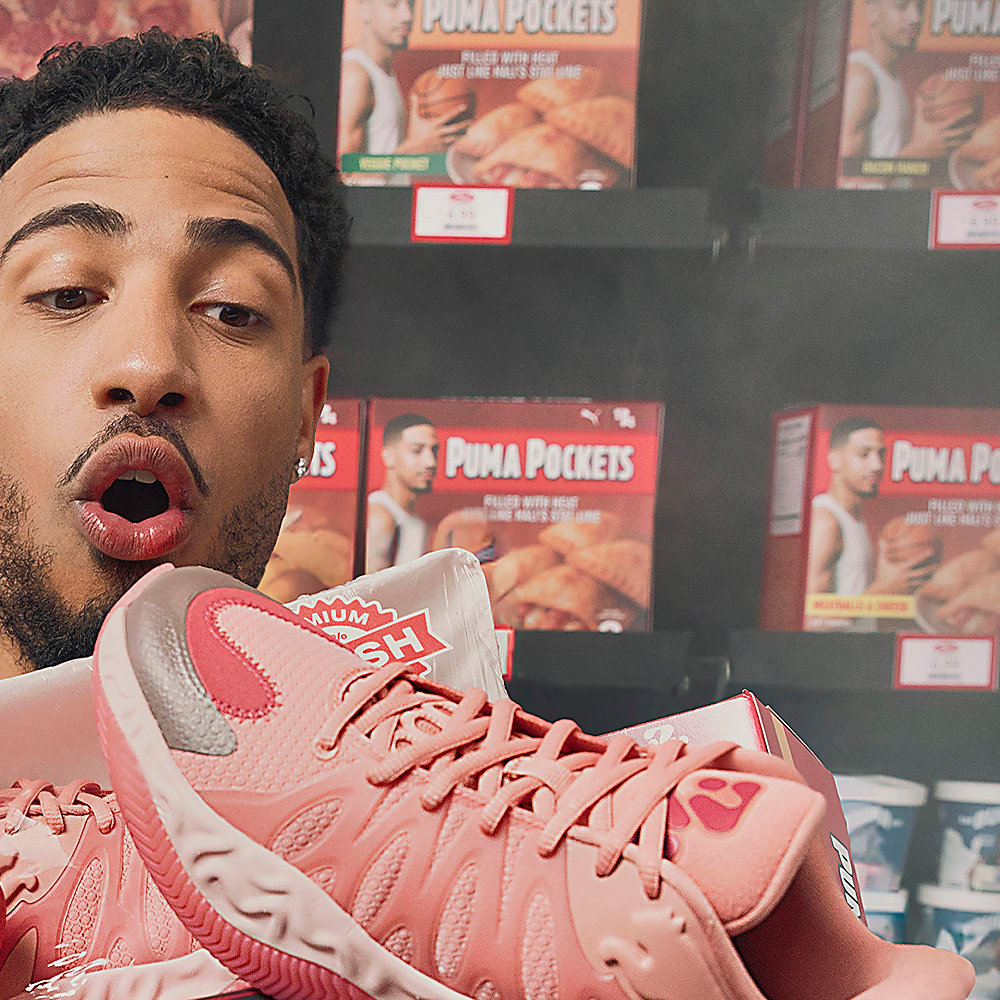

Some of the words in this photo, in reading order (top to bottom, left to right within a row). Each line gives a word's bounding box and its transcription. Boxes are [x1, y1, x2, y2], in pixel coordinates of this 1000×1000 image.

[422, 0, 499, 34] PUMA
[504, 0, 617, 34] POCKETS
[445, 436, 522, 480] PUMA
[525, 437, 635, 481] POCKETS
[891, 438, 968, 484] PUMA
